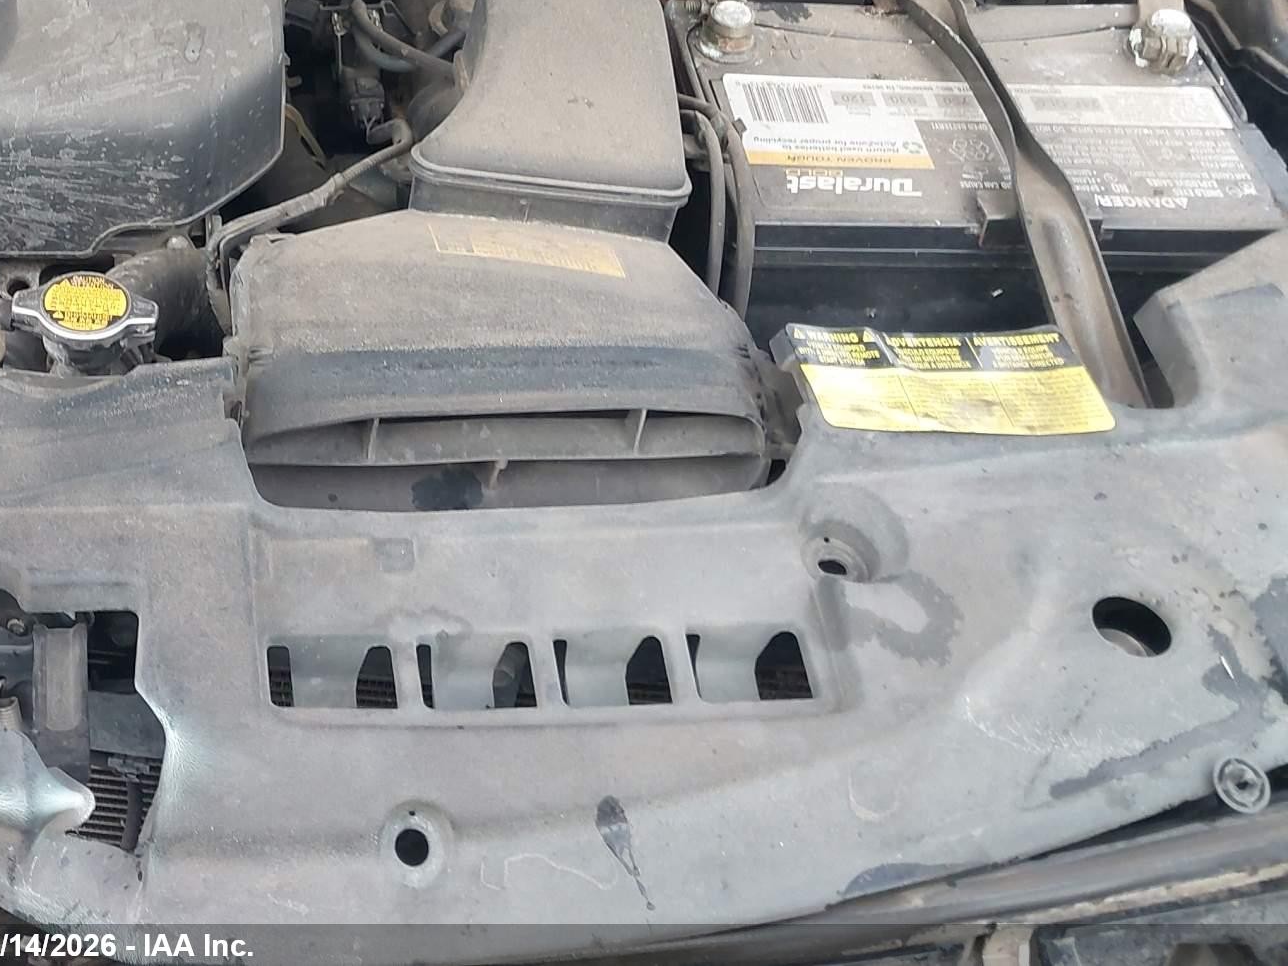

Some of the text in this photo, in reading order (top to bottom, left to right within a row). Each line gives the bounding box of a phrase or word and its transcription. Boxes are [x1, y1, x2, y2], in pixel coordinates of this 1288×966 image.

[836, 155, 893, 164] PROVEN
[785, 175, 923, 198] Duralast
[806, 330, 859, 344] WARNING
[972, 332, 1060, 347] AVERTISSEMENT
